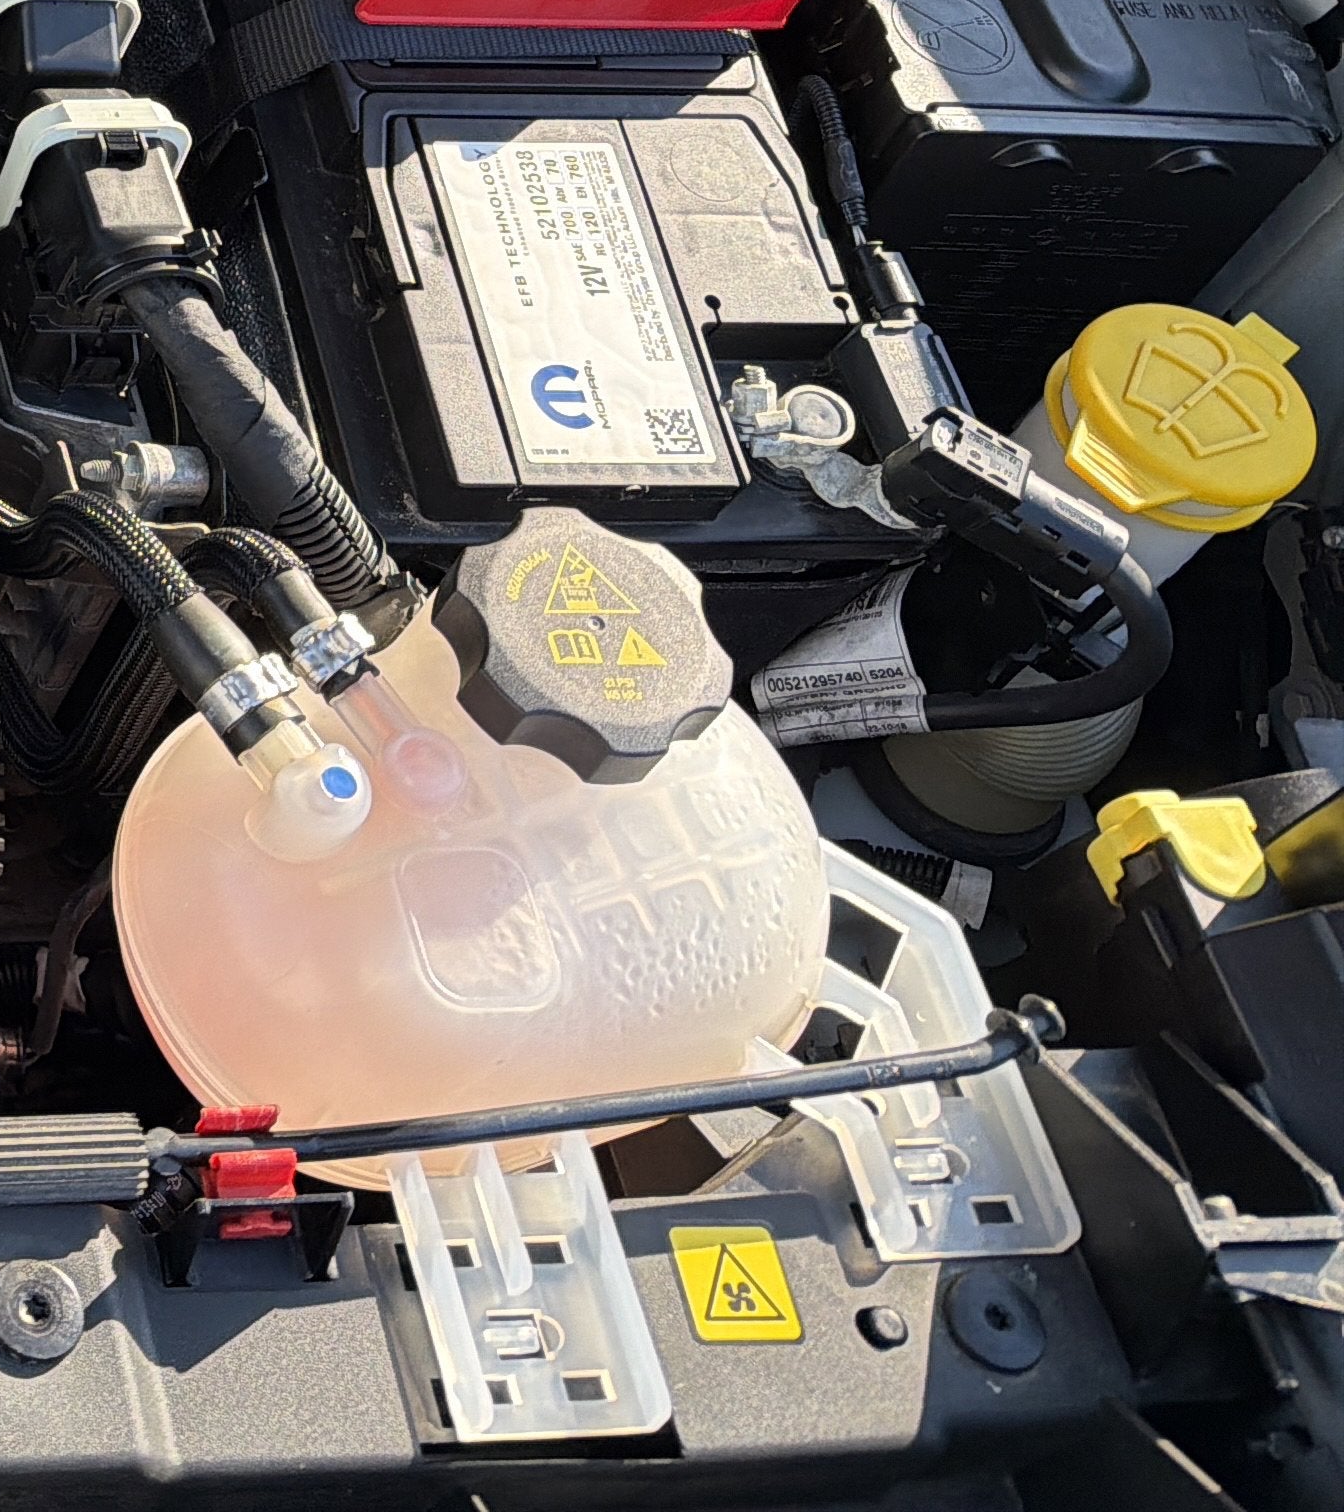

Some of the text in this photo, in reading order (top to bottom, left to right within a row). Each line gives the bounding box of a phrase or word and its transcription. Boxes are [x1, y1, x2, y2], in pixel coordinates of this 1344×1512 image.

[1113, 0, 1156, 18] FUSE
[1163, 3, 1195, 20] AND
[543, 159, 560, 175] 70
[515, 150, 560, 240] 52102538
[473, 148, 534, 306] EFB TECHNOLOGY
[560, 211, 580, 235] 700
[581, 211, 602, 235] 120
[593, 242, 607, 256] RC
[577, 264, 609, 296] 12V
[767, 667, 904, 693] 00521295740 5204
